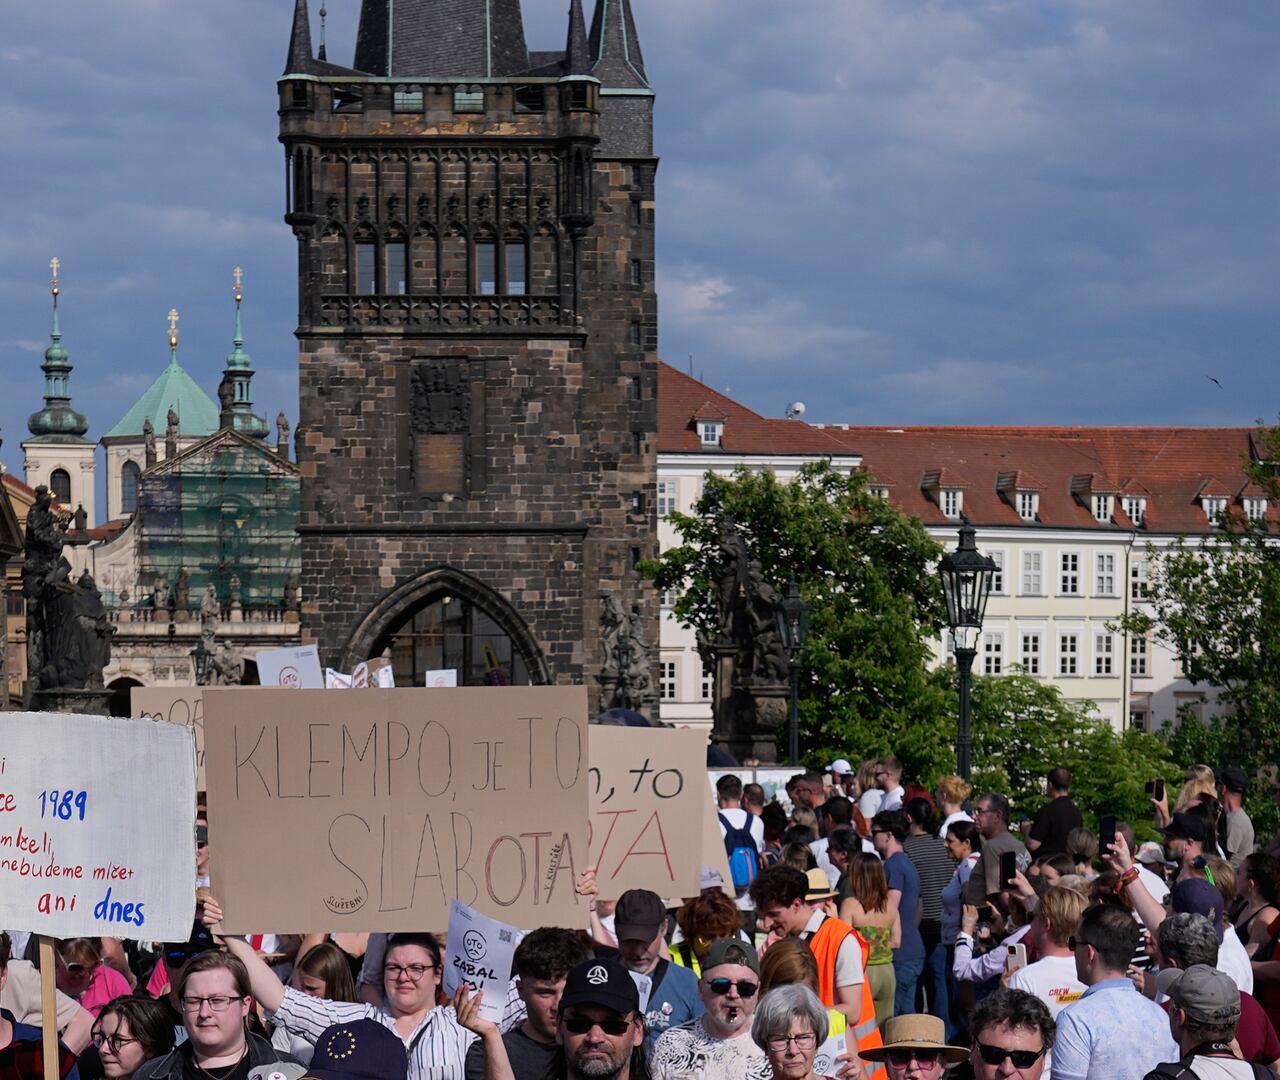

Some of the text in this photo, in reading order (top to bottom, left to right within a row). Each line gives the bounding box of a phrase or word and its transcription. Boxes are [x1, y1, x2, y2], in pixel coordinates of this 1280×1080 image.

[235, 719, 457, 801] KLEMPO,
[473, 741, 505, 791] JE
[518, 716, 582, 790] TO
[629, 758, 684, 799] to
[38, 789, 88, 822] 1989
[1, 856, 135, 881] nebudeme mlčet
[37, 886, 145, 927] ani dnes
[466, 937, 483, 950] OTO
[452, 954, 499, 981] ZABAL
[1048, 988, 1070, 997] CREW
